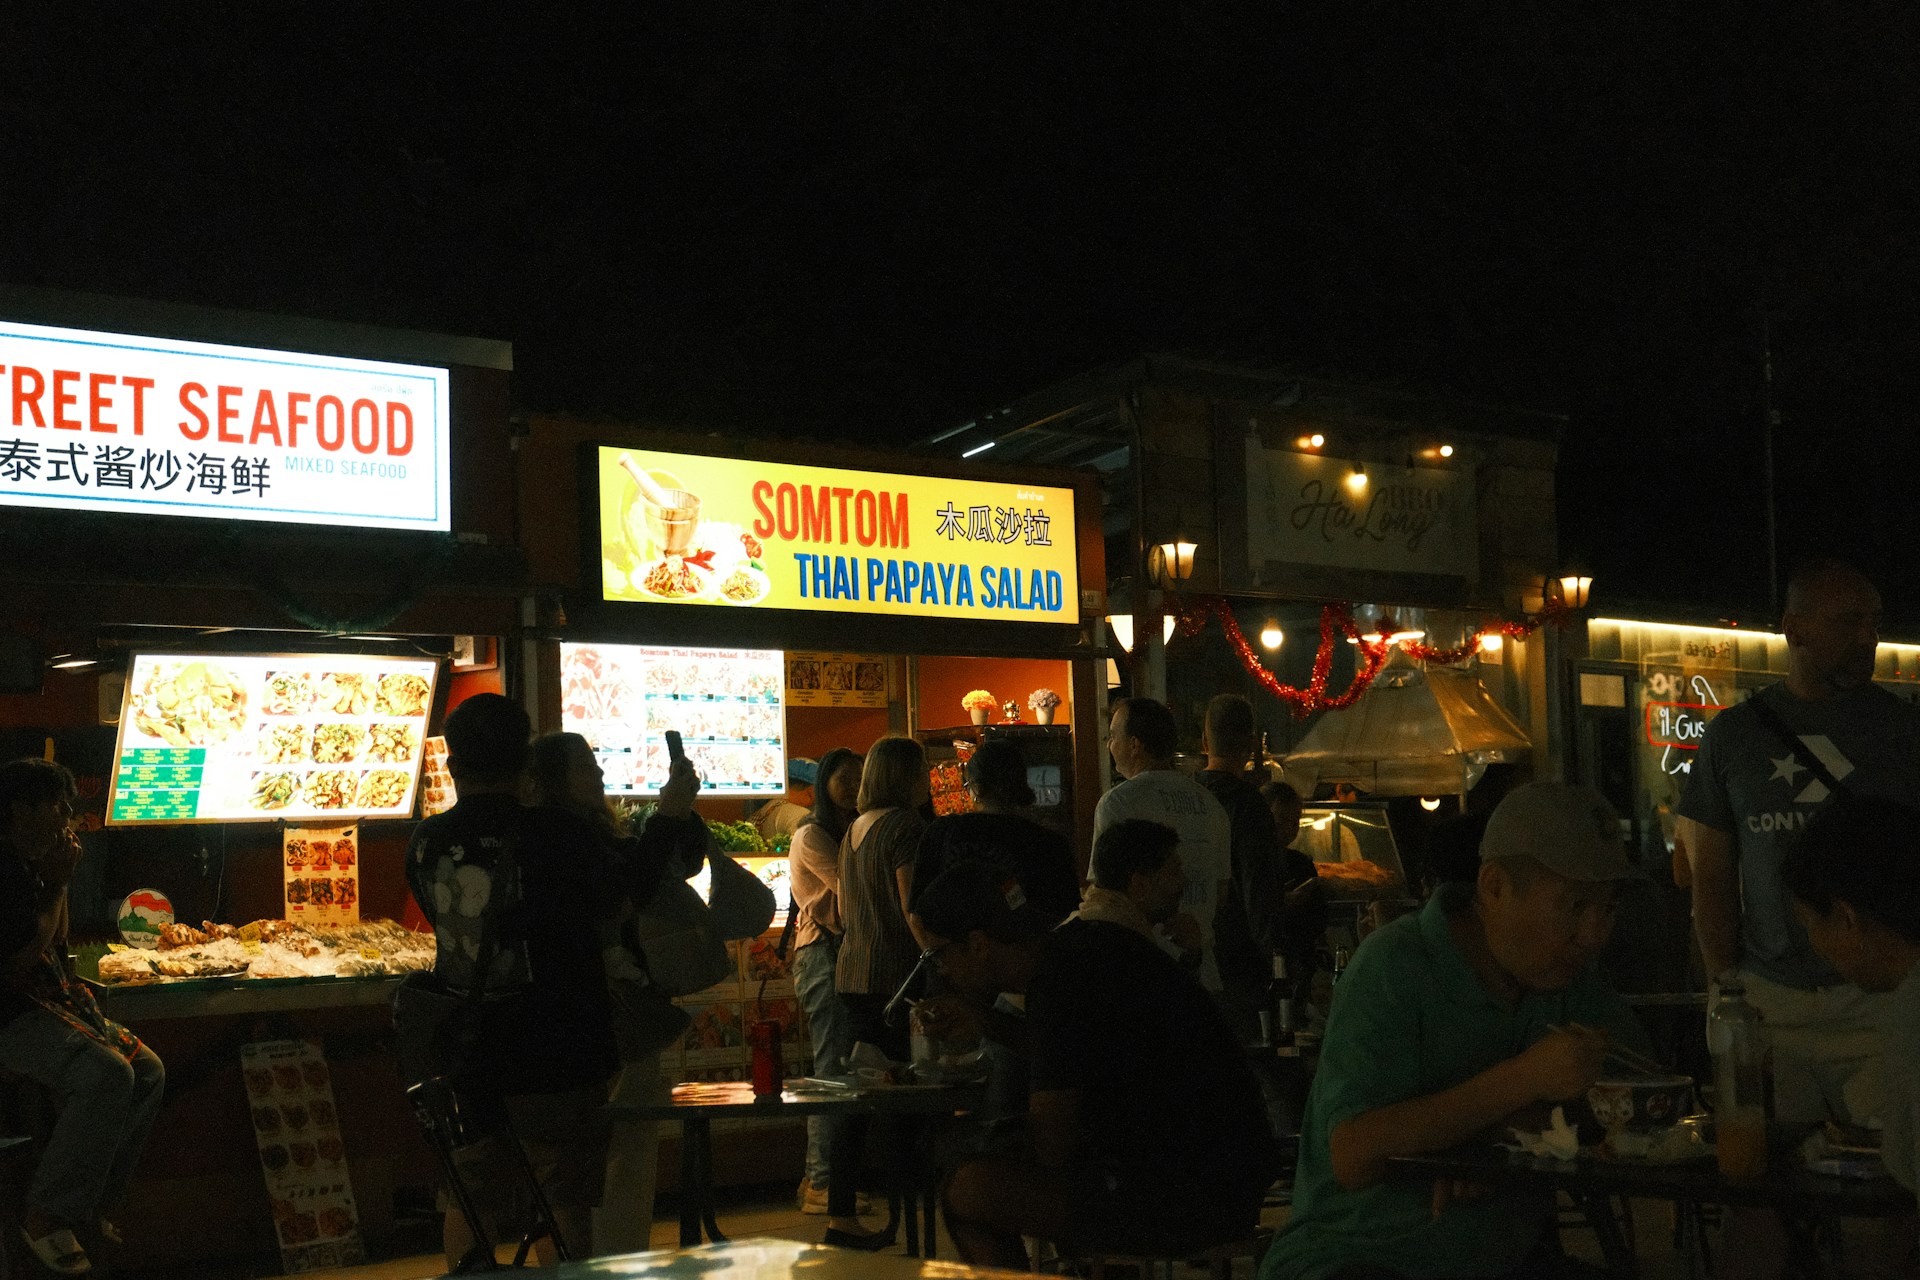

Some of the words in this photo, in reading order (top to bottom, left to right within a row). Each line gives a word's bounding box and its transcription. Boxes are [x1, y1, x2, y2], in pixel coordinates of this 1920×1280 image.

[0, 364, 155, 436] REET
[178, 382, 413, 456] SEAFOOD
[0, 438, 271, 498] 泰式酱炒海鲜
[285, 455, 335, 475] MIXED
[341, 459, 408, 480] SEAFOOD
[752, 480, 910, 549] SOMTOM
[935, 502, 1053, 547] 木瓜沙拉
[794, 553, 860, 601] THAI
[867, 558, 975, 608] PAPAYA
[980, 565, 1063, 613] SALAD
